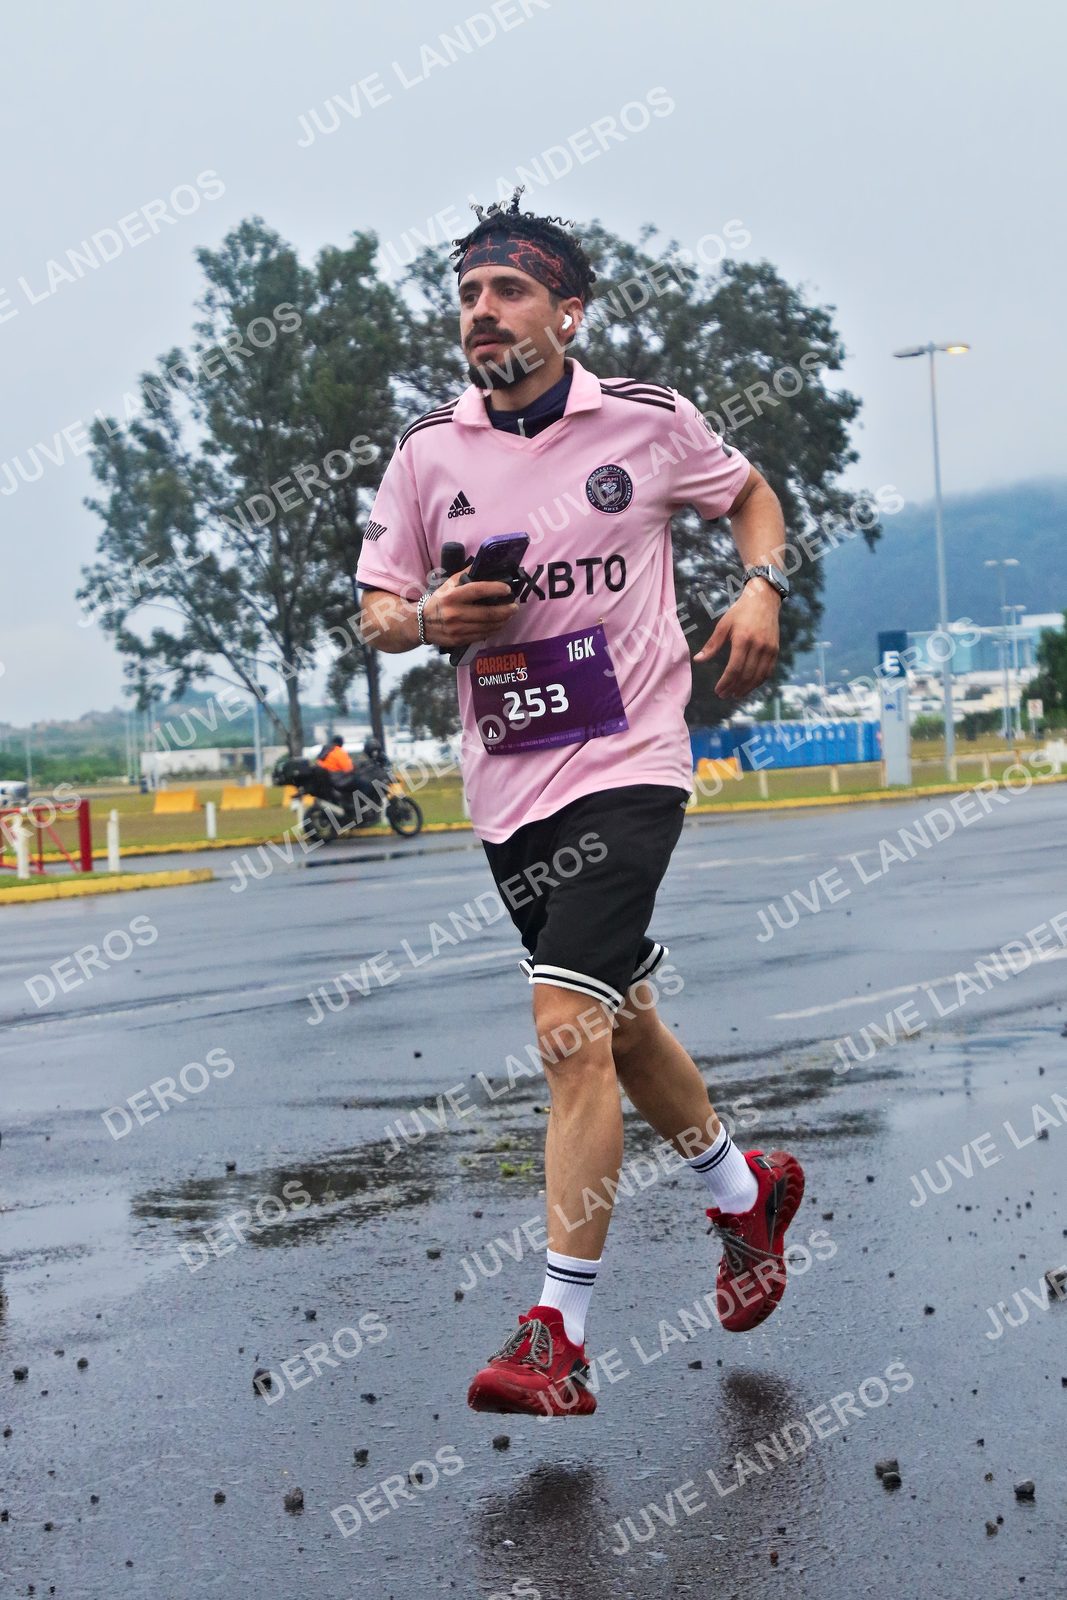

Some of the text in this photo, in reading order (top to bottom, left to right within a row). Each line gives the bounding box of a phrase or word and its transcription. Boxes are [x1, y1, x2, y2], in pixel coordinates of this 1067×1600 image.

[447, 505, 476, 520] adidas
[518, 554, 627, 604] XBTO
[566, 636, 596, 662] 15K
[476, 652, 527, 675] CARRERA
[883, 650, 901, 673] E
[503, 683, 569, 720] 253
